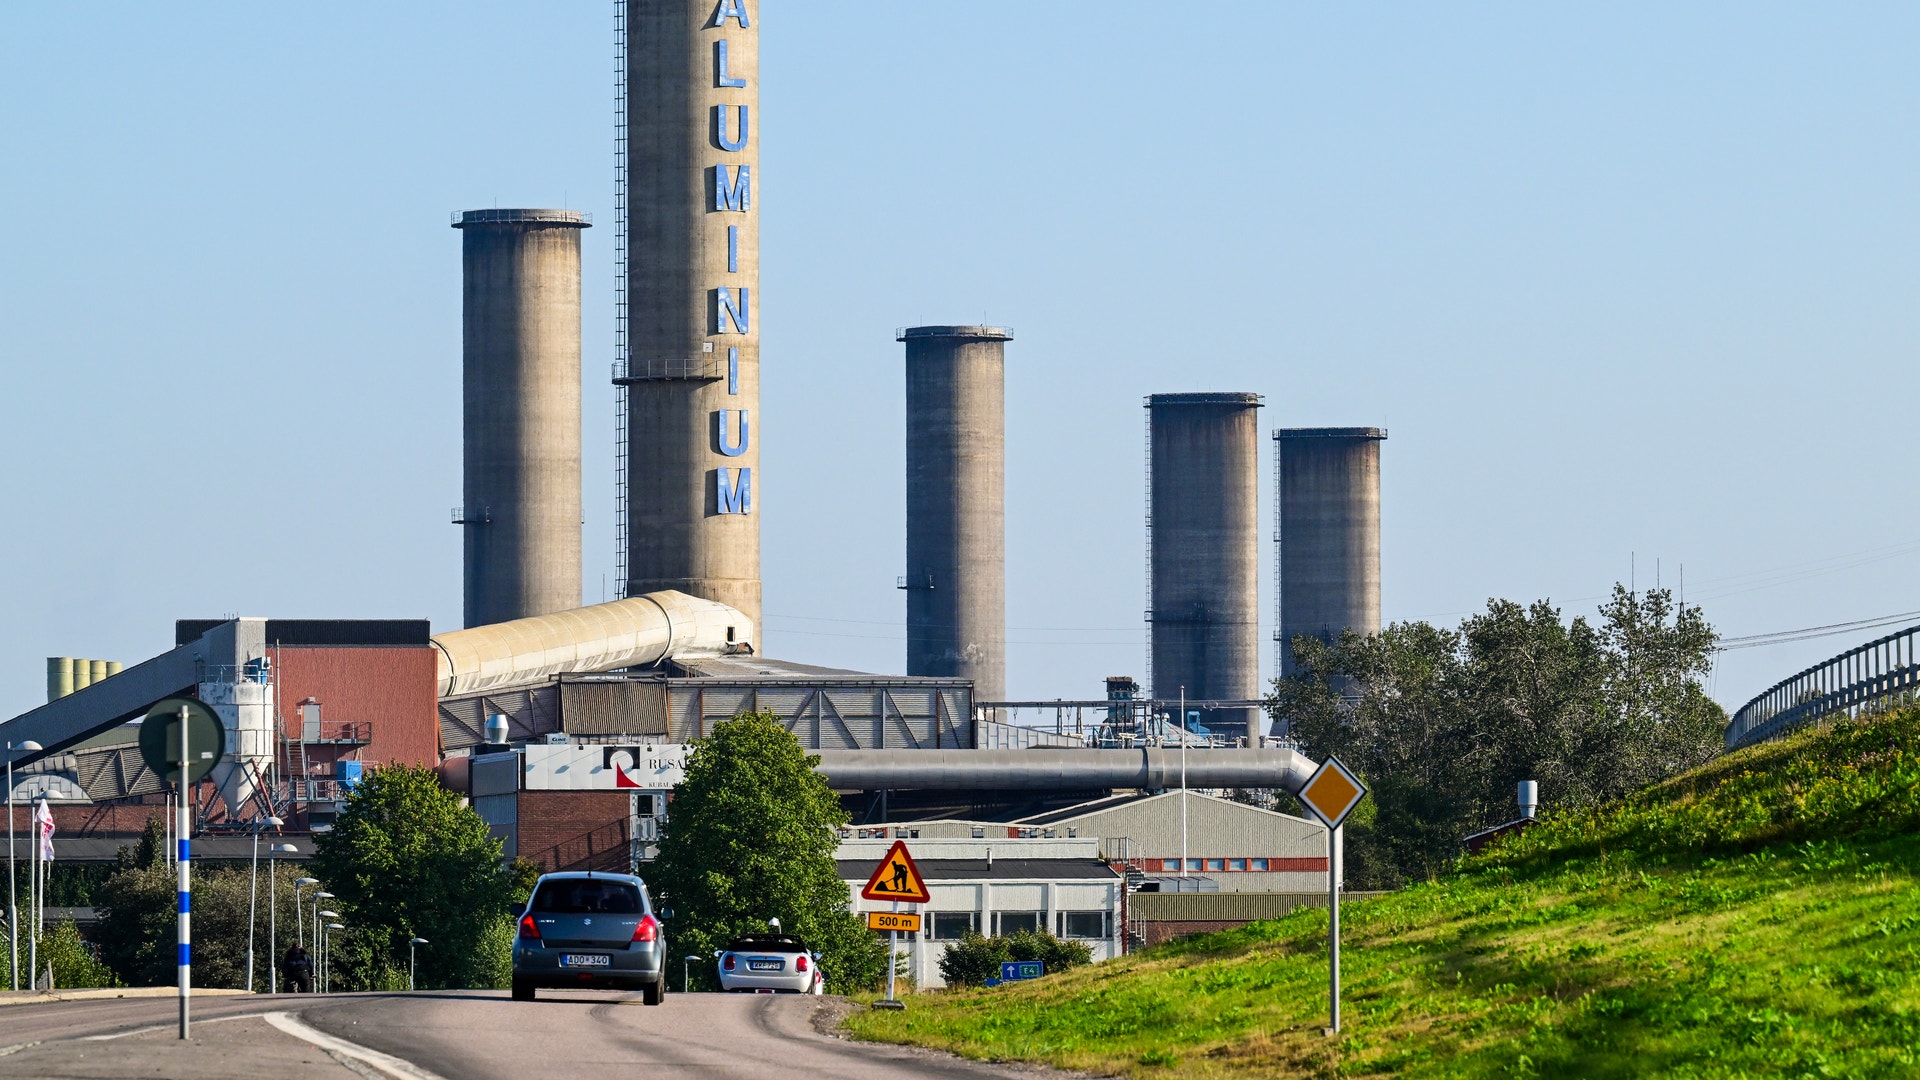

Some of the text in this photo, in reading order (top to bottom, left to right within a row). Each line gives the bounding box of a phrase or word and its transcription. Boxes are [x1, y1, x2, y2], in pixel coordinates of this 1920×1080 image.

[715, 0, 751, 514] ALUMINIUM
[879, 916, 912, 927] 500 m
